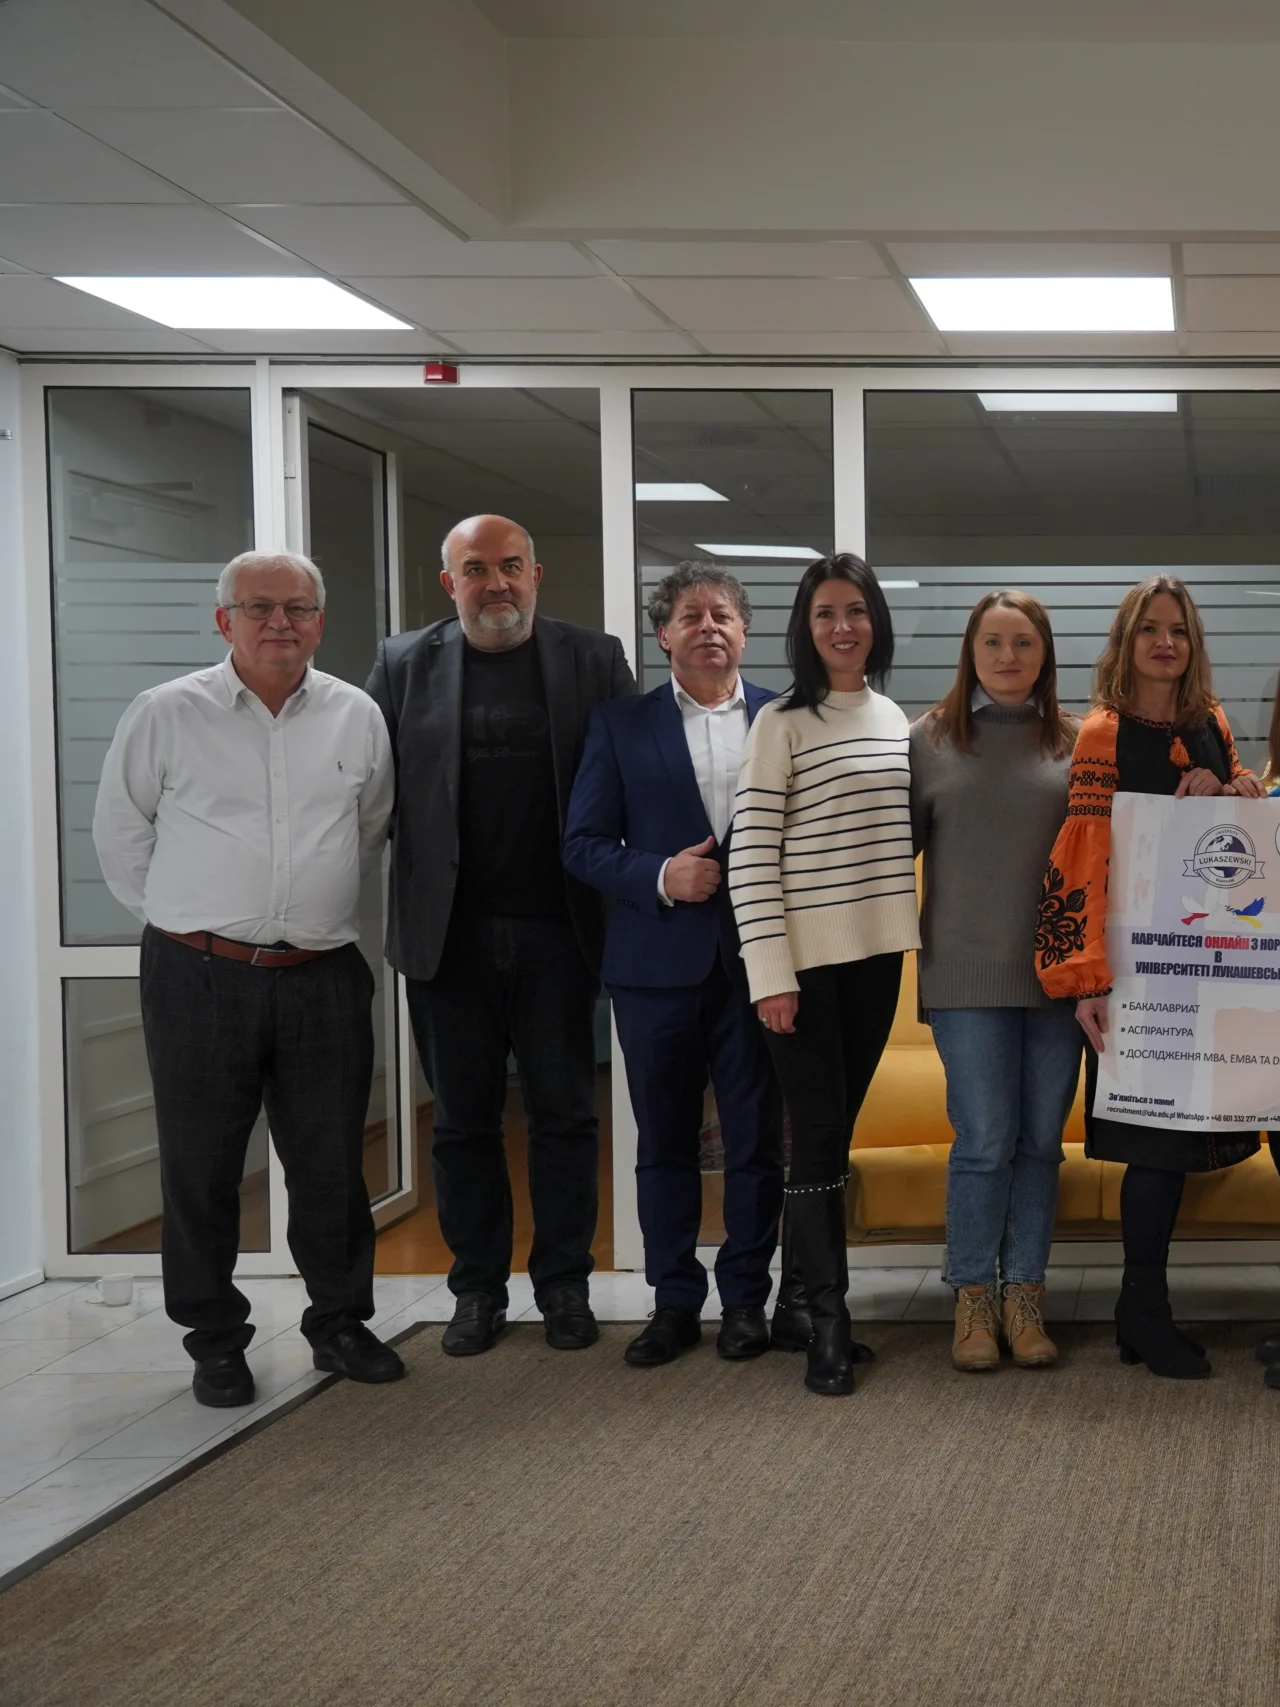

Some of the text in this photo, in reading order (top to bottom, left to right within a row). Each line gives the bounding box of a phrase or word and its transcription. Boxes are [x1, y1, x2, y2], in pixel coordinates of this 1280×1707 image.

[1131, 932, 1203, 948] НАВЧАЙТЕСЯ
[1204, 935, 1250, 950] ОНЛАЙН
[1251, 938, 1259, 951] З
[1214, 950, 1223, 963] В
[1135, 961, 1210, 977] УНІВЕРСИТЕТІ
[1129, 1001, 1201, 1014] БАКАЛАВРИАТ
[1127, 1025, 1194, 1037] АСПІРАНТУРА
[1126, 1049, 1201, 1061] ДОСЛІДЖЕННЯ
[1153, 1098, 1175, 1106] нами!
[1106, 1105, 1176, 1120] recruitment@ulu.edu.pl
[1176, 1112, 1205, 1122] WhatsApp
[1246, 1115, 1257, 1123] 277
